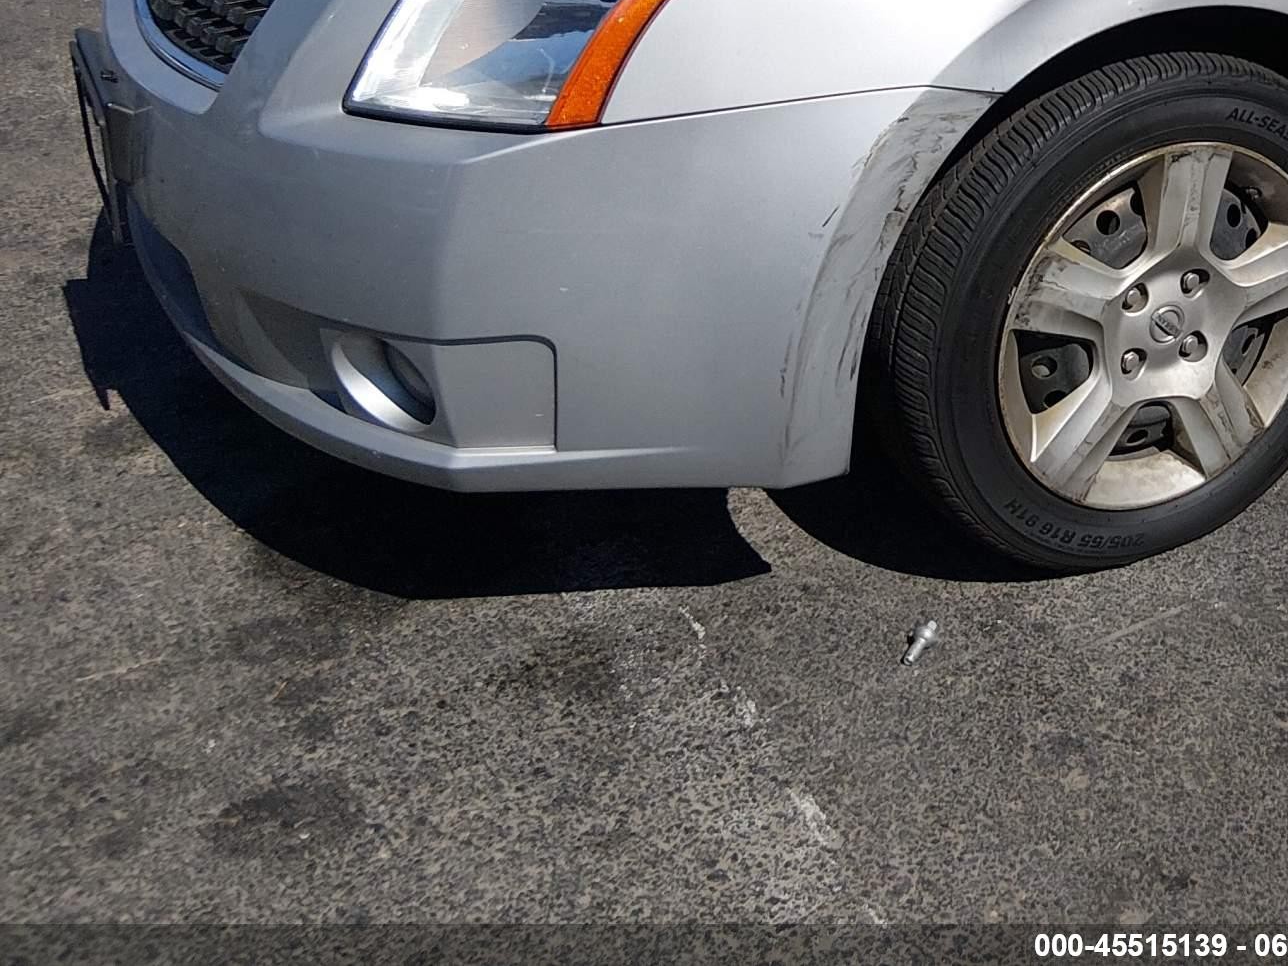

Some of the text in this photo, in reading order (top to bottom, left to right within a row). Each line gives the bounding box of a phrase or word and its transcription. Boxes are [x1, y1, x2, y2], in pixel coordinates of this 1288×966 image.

[1003, 497, 1145, 549] 205/55 R16 91H
